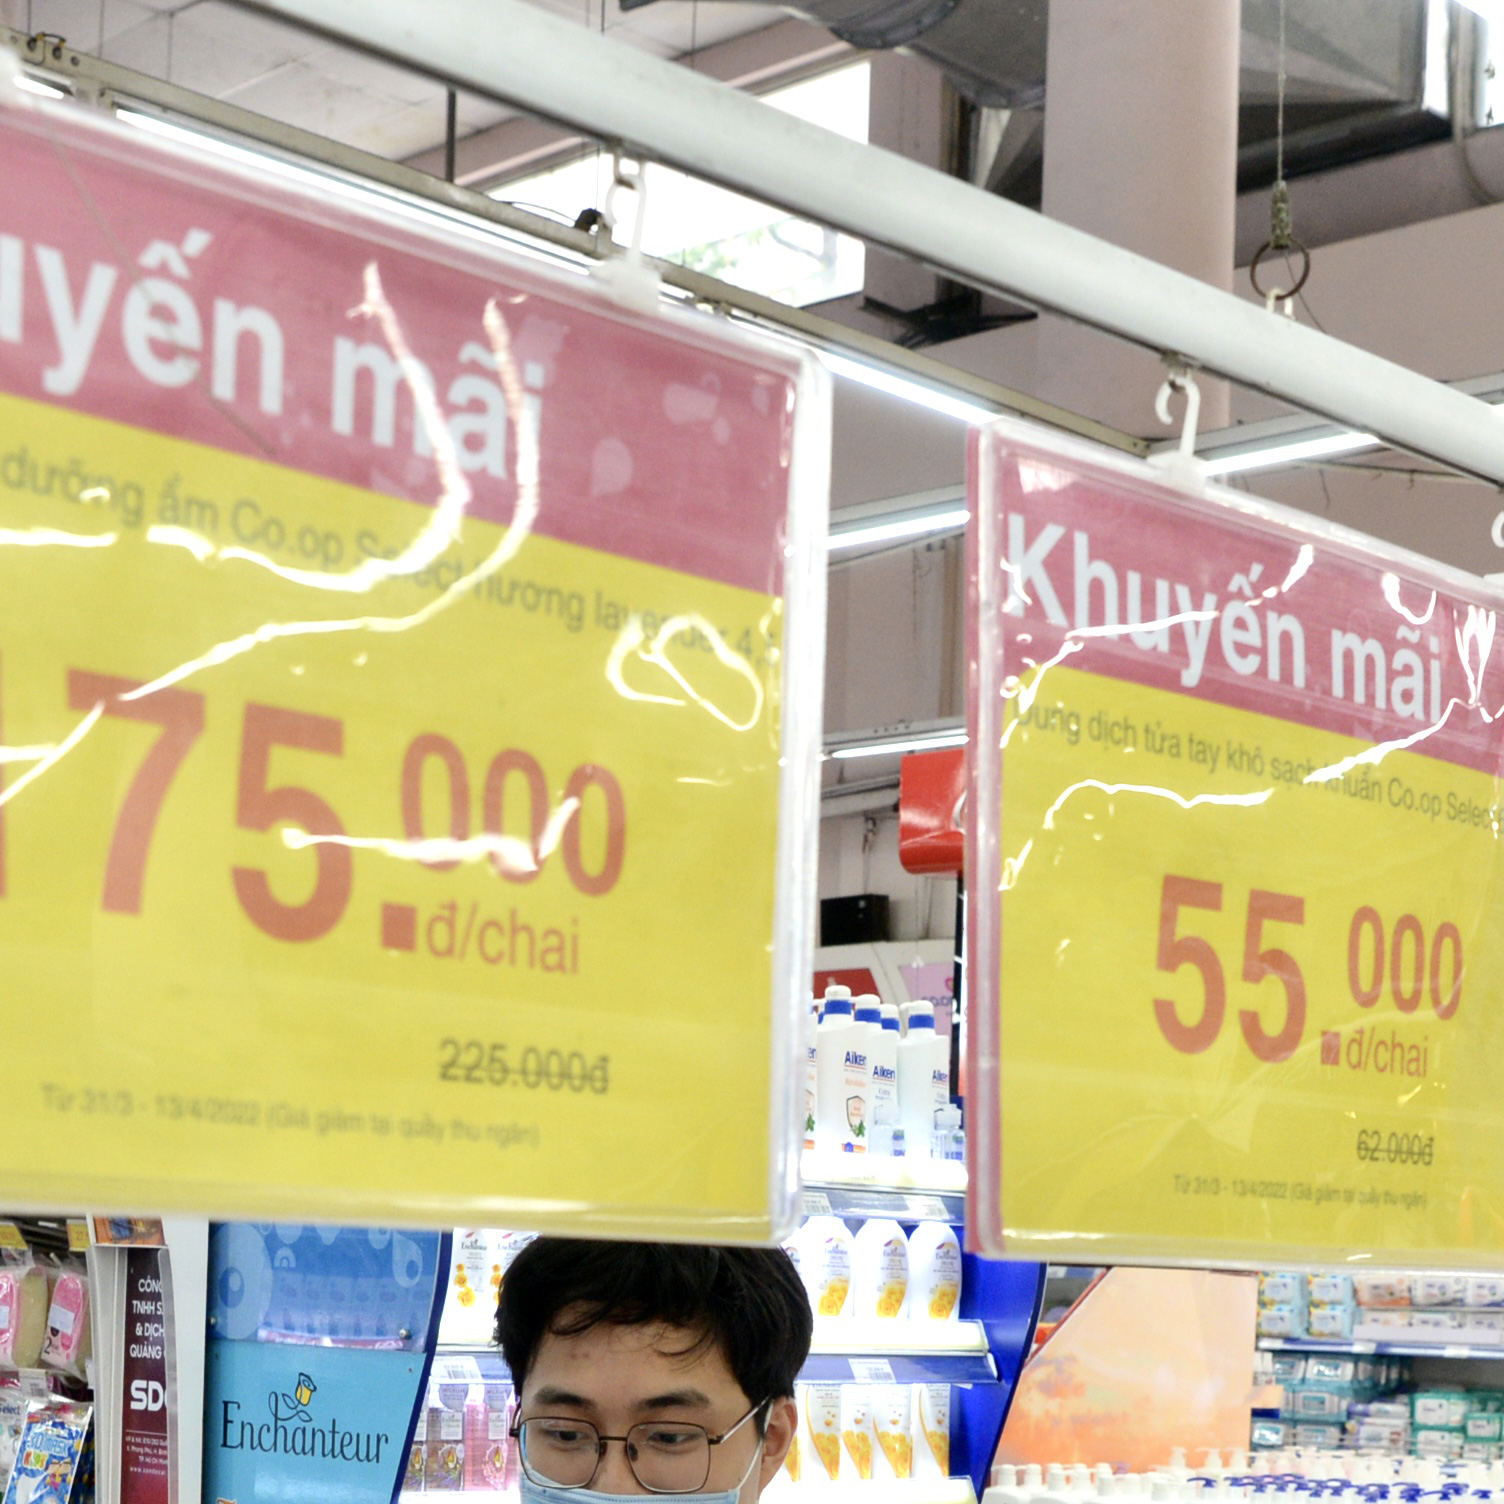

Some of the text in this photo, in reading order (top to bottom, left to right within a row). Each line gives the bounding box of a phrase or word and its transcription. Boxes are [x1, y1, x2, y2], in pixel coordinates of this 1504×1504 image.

[330, 330, 545, 479] mãi
[0, 444, 145, 526] dưỡng
[230, 499, 344, 566] Co.op
[1006, 513, 1441, 723] Khuyến mãi
[1088, 713, 1138, 757] dịch
[1188, 736, 1222, 775] tay
[1226, 738, 1265, 777] khô
[1387, 777, 1441, 820] Co.op
[426, 899, 580, 976] đ/chai
[873, 1065, 895, 1079] Aiken
[1347, 1026, 1429, 1079] đ/chai
[1357, 1129, 1434, 1166] 62.000đ
[132, 1301, 155, 1316] TNHH
[135, 1323, 143, 1336] &
[130, 1342, 162, 1360] QUẢNG
[130, 1379, 168, 1412] SD
[221, 1391, 389, 1464] Enchanteur
